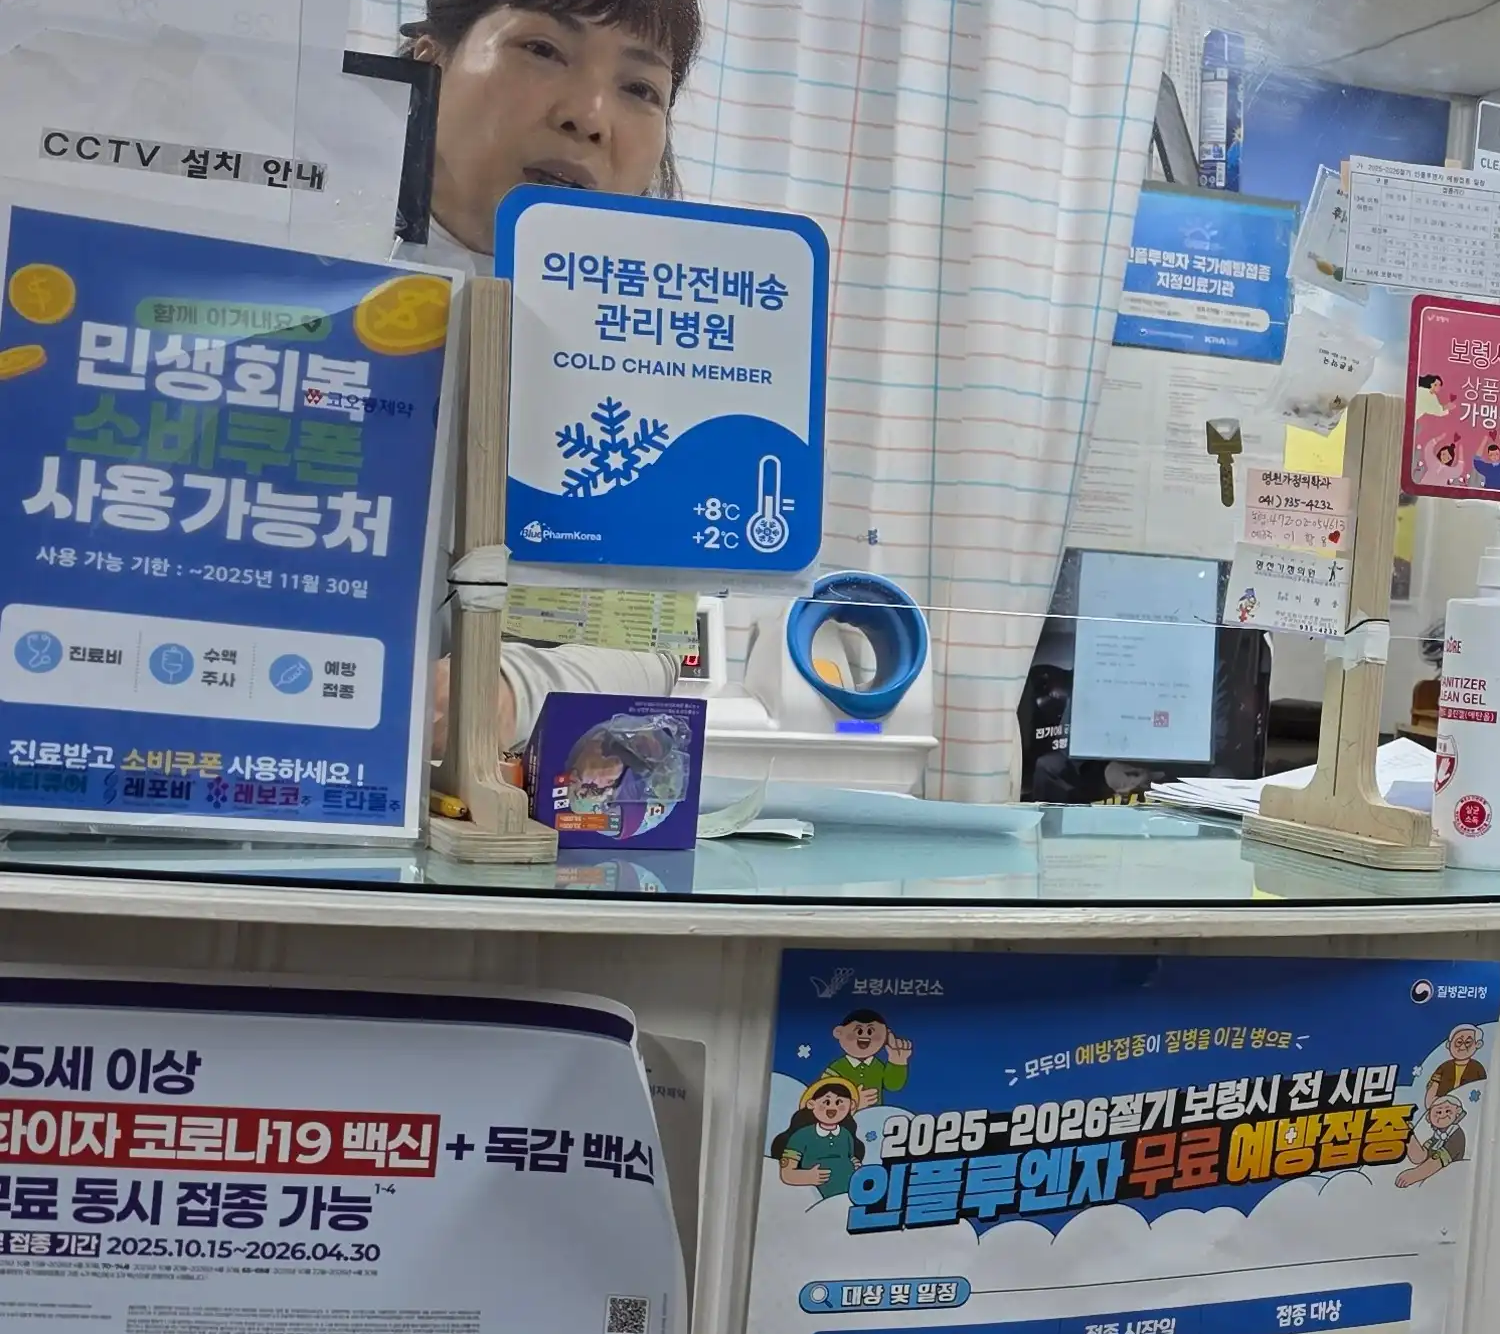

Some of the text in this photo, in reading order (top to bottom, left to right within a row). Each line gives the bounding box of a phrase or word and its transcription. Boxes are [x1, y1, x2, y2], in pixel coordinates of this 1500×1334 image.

[42, 131, 325, 189] CCTV 설치 안내
[1193, 255, 1271, 281] 국가예방접종
[1157, 271, 1235, 297] 지정의료기관
[152, 303, 296, 333] 함께 이겨내요
[76, 320, 373, 423] 민생회복
[553, 351, 772, 384] COLD CHAIN MEMBER
[65, 392, 365, 487] 소비쿠폰
[37, 546, 78, 569] 사용
[84, 549, 124, 574] 가능
[131, 554, 170, 577] 기한
[279, 570, 319, 595] 11월
[325, 575, 369, 600] 30일
[69, 643, 123, 666] 진료비
[203, 646, 238, 666] 수액
[324, 659, 357, 678] 예방
[201, 669, 236, 689] 주사
[1463, 694, 1486, 706] GEL
[9, 739, 223, 778] 진료받고 소비쿠폰
[124, 777, 191, 801] 레포비
[852, 976, 944, 997] 보령시보건소
[1437, 985, 1487, 1001] 질병관리청
[1024, 1027, 1292, 1080] 모두의 예방접종이 질병을 이길 병으로
[105, 1048, 201, 1096] 이상
[881, 1064, 1399, 1160] 2025-2026절기 보령시 전 시민
[129, 1113, 331, 1166] 코로나19
[342, 1119, 432, 1170] 백신
[484, 1126, 574, 1174] 독감
[582, 1133, 654, 1185] 백신
[848, 1104, 1414, 1233] 인플루엔자 무료 예방접종
[71, 1177, 268, 1231] 동시 접종
[57, 1235, 100, 1258] 기간
[841, 1282, 958, 1307] 대상 및 일정
[1311, 1299, 1342, 1320] 대상
